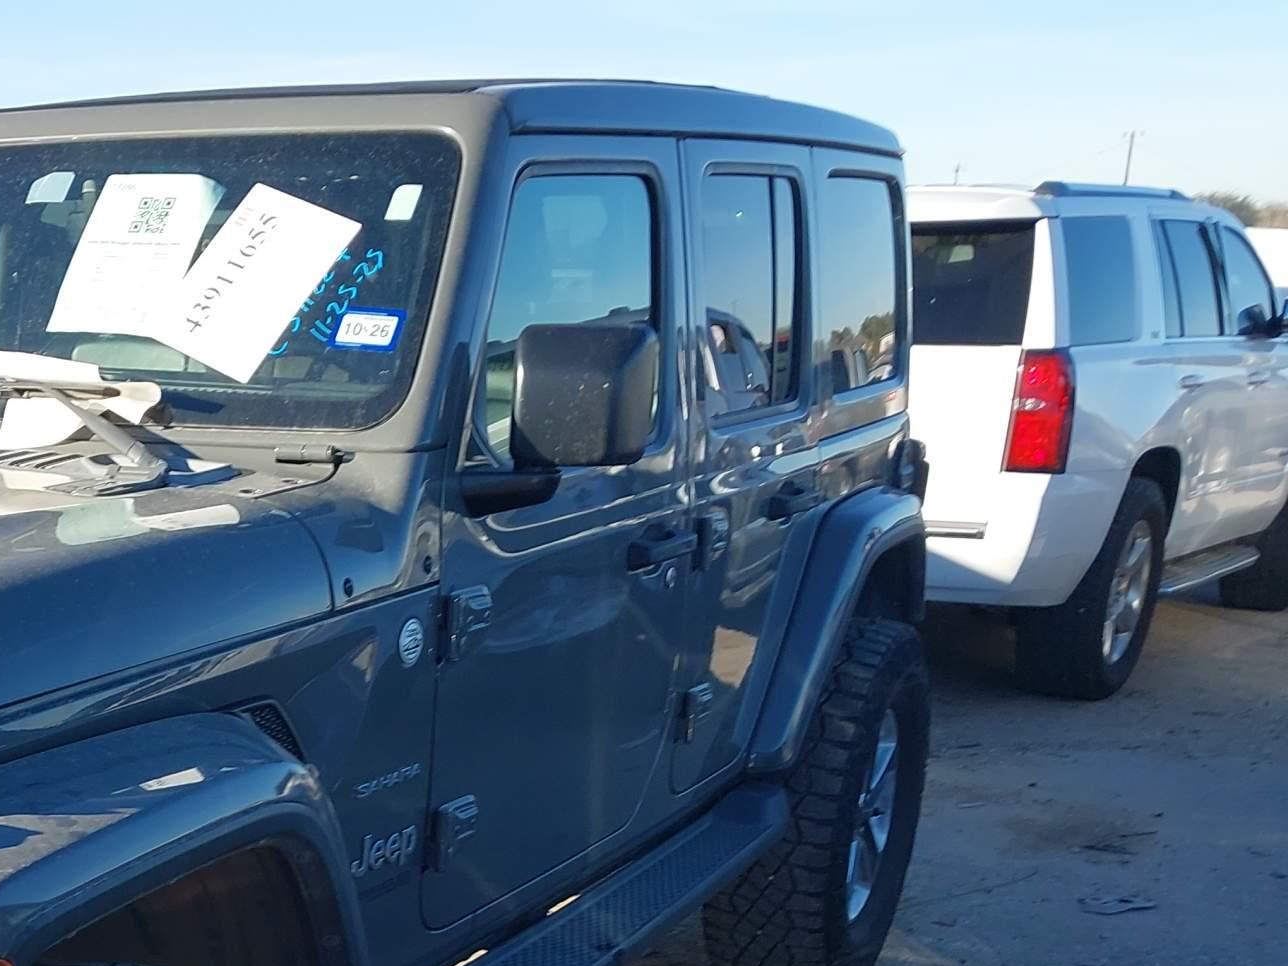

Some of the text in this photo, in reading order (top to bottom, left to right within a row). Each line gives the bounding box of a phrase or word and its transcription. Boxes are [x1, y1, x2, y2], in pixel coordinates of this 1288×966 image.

[186, 212, 278, 333] 43911655
[352, 762, 423, 799] SAHARA
[351, 824, 417, 878] Jeep
